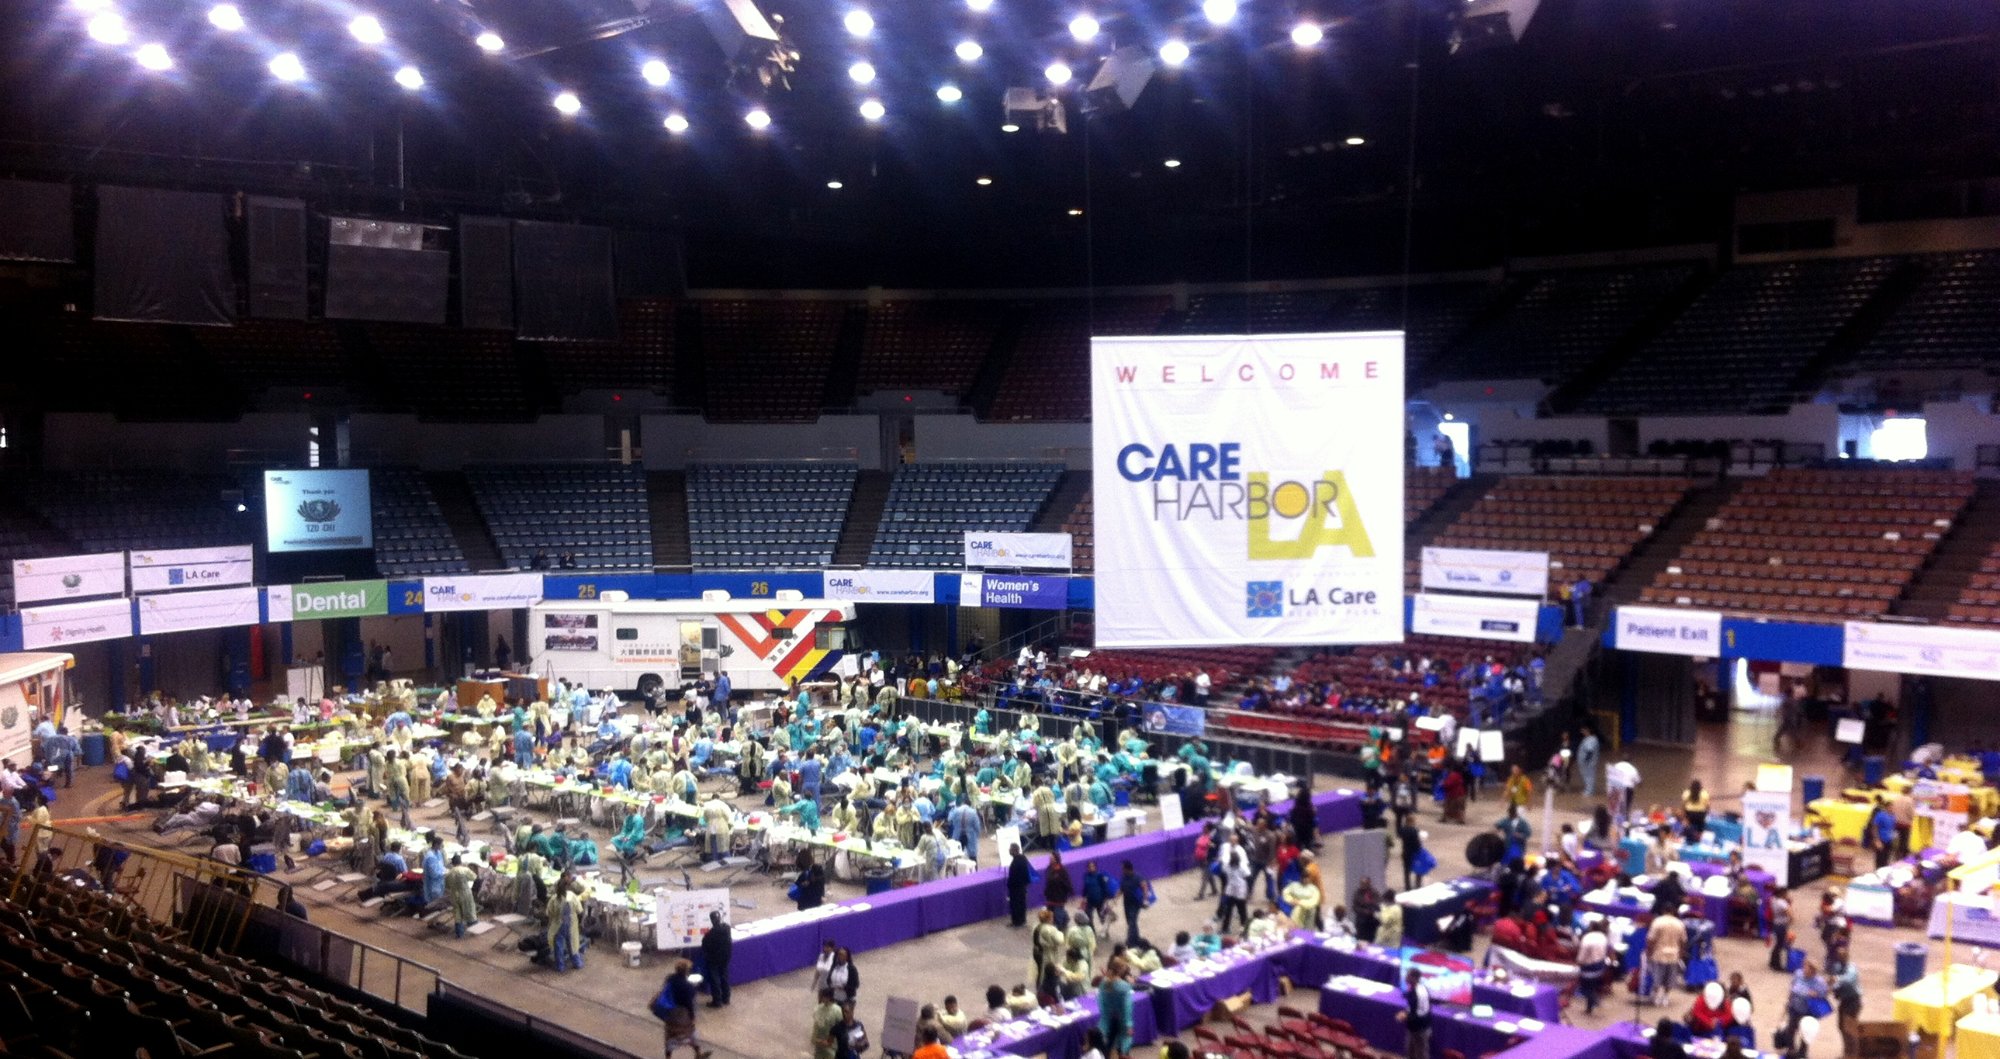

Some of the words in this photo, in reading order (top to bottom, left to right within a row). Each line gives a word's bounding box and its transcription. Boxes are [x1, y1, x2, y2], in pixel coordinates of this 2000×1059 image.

[1116, 361, 1378, 383] WELCOME
[1117, 443, 1241, 482] CARE
[1153, 480, 1339, 521] HARBOR
[1247, 470, 1376, 560] LA
[970, 541, 993, 550] CARE
[201, 569, 221, 579] Care
[751, 582, 769, 595] 26
[829, 578, 854, 587] CARE
[986, 579, 1040, 592] Women's
[430, 586, 456, 595] CARE
[578, 584, 596, 599] 25
[1328, 587, 1377, 605] Care
[295, 589, 366, 613] Dental
[405, 591, 423, 606] 24
[985, 592, 1023, 605] Health
[1626, 622, 1676, 639] Patient
[1746, 827, 1782, 849] LA
